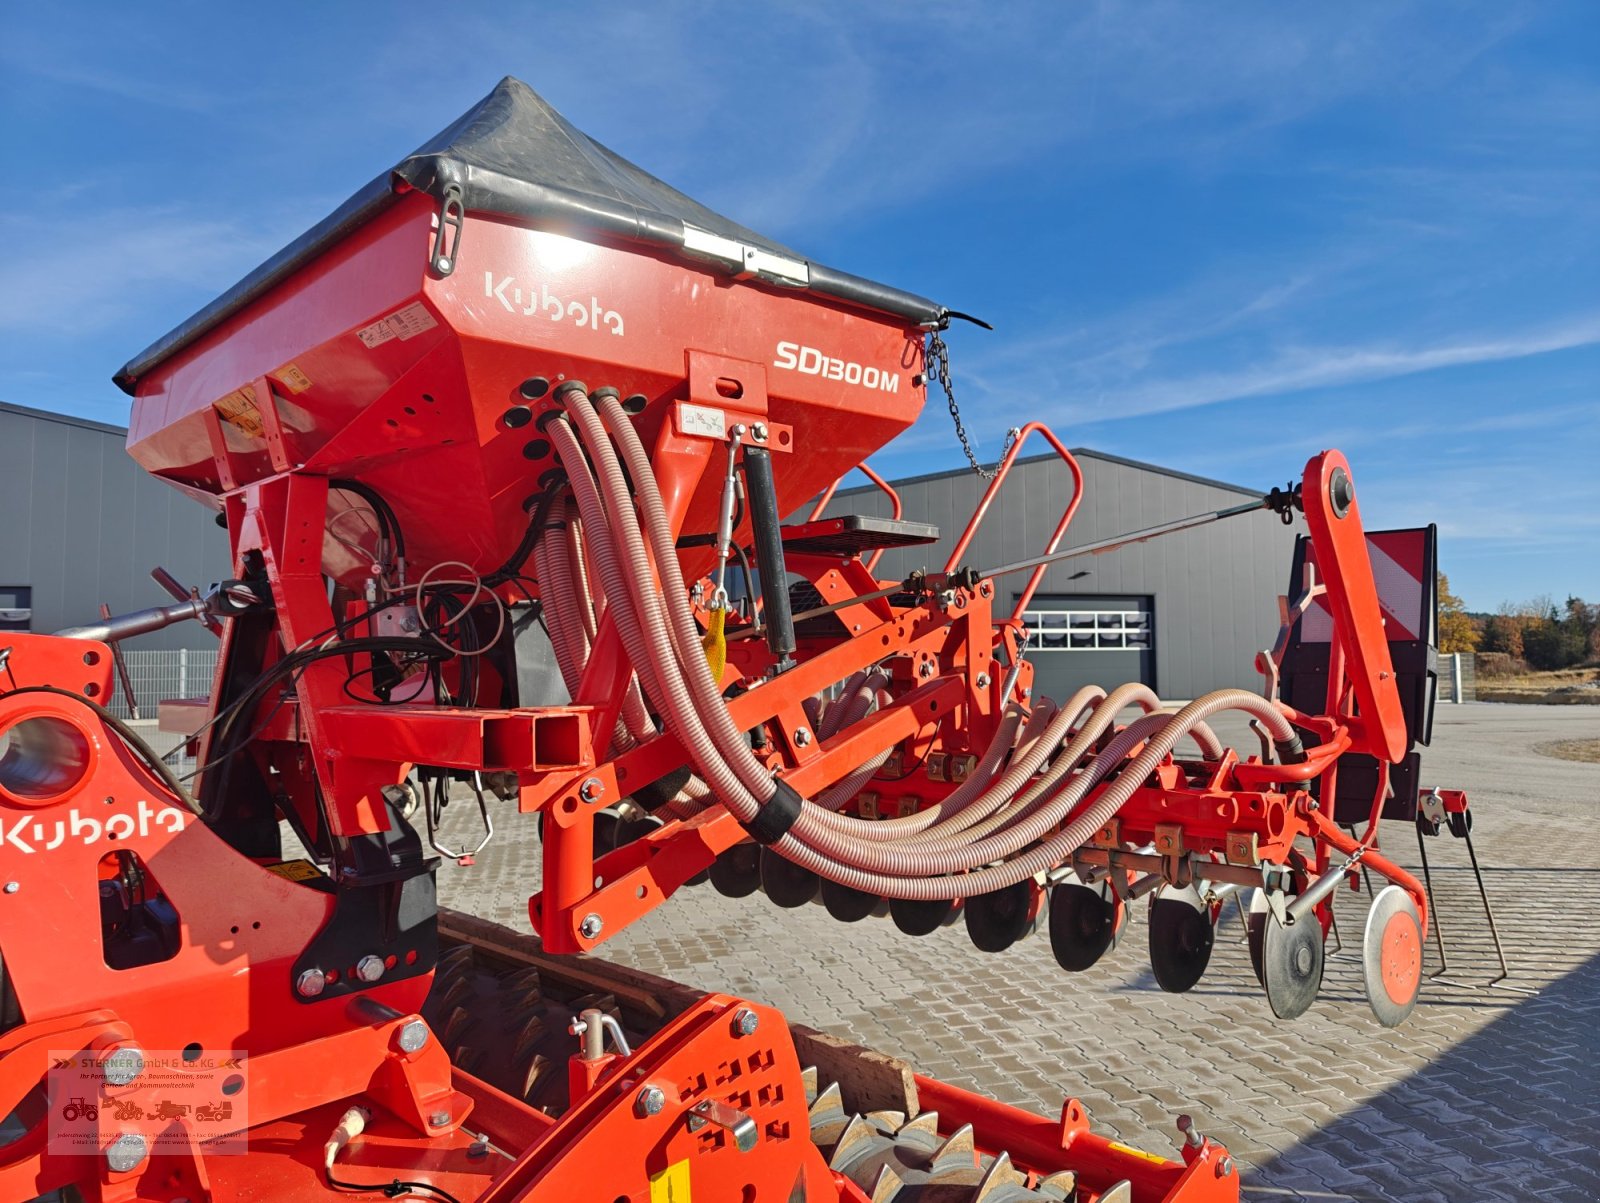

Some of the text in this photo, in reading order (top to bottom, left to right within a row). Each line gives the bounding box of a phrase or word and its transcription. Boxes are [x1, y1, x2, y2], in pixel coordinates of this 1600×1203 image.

[485, 271, 624, 336] Kubota
[773, 341, 899, 393] SD1300M
[0, 801, 185, 854] Kubota
